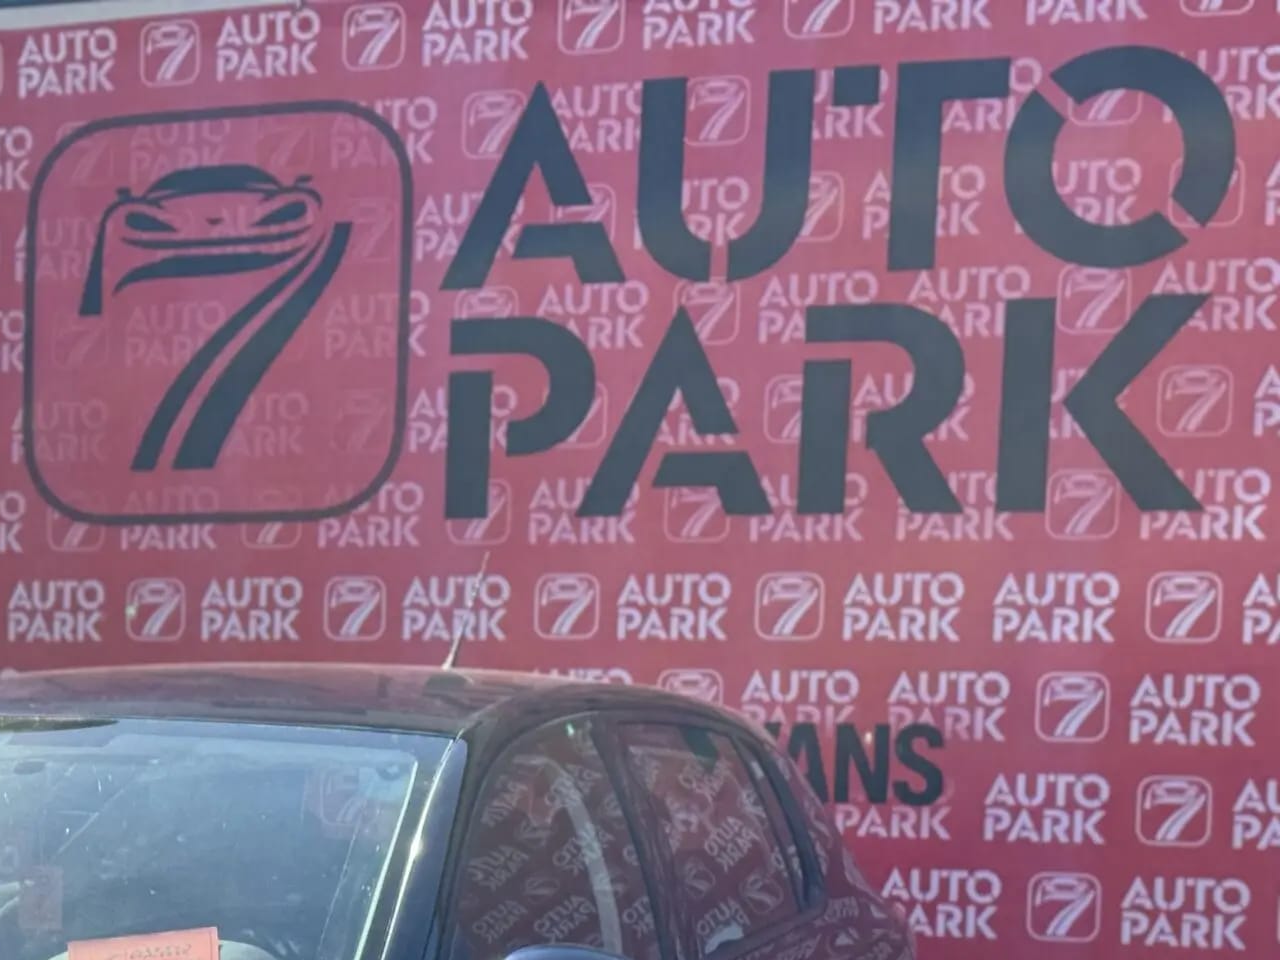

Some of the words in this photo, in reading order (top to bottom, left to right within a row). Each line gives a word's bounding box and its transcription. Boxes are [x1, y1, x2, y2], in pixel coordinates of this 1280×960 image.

[217, 9, 320, 46] AUTO
[422, 0, 533, 30] AUTO
[642, 9, 756, 50] PARK
[874, 0, 991, 34] PARK
[17, 28, 116, 65] AUTO
[216, 41, 317, 81] PARK
[422, 26, 529, 67] PARK
[17, 60, 115, 99] PARK
[440, 45, 1236, 289] AUTO
[537, 281, 649, 316] AUTO
[759, 271, 878, 306] AUTO
[909, 266, 1031, 302] AUTO
[445, 293, 1212, 519] PARK
[318, 512, 420, 549] PARK
[529, 511, 635, 545] PARK
[748, 510, 863, 542] PARK
[896, 508, 1014, 542] PARK
[1139, 504, 1267, 541] PARK
[9, 580, 105, 611] AUTO
[202, 577, 302, 610] AUTO
[403, 575, 511, 609] AUTO
[618, 573, 731, 608] AUTO
[845, 572, 965, 607] AUTO
[993, 572, 1120, 607] AUTO
[8, 611, 102, 642] PARK
[201, 609, 301, 642] PARK
[403, 608, 507, 641] PARK
[618, 607, 727, 641] PARK
[843, 606, 960, 642] PARK
[993, 607, 1115, 642] PARK
[741, 670, 860, 704] AUTO
[888, 670, 1010, 705] AUTO
[1130, 674, 1260, 709] AUTO
[1129, 710, 1255, 746] PARK
[984, 773, 1110, 808] AUTO
[836, 805, 951, 840] PARK
[984, 808, 1105, 844] PARK
[882, 867, 1002, 902] AUTO
[1121, 876, 1251, 915] AUTO
[908, 902, 997, 939] ARK
[1120, 911, 1246, 951] PARK
